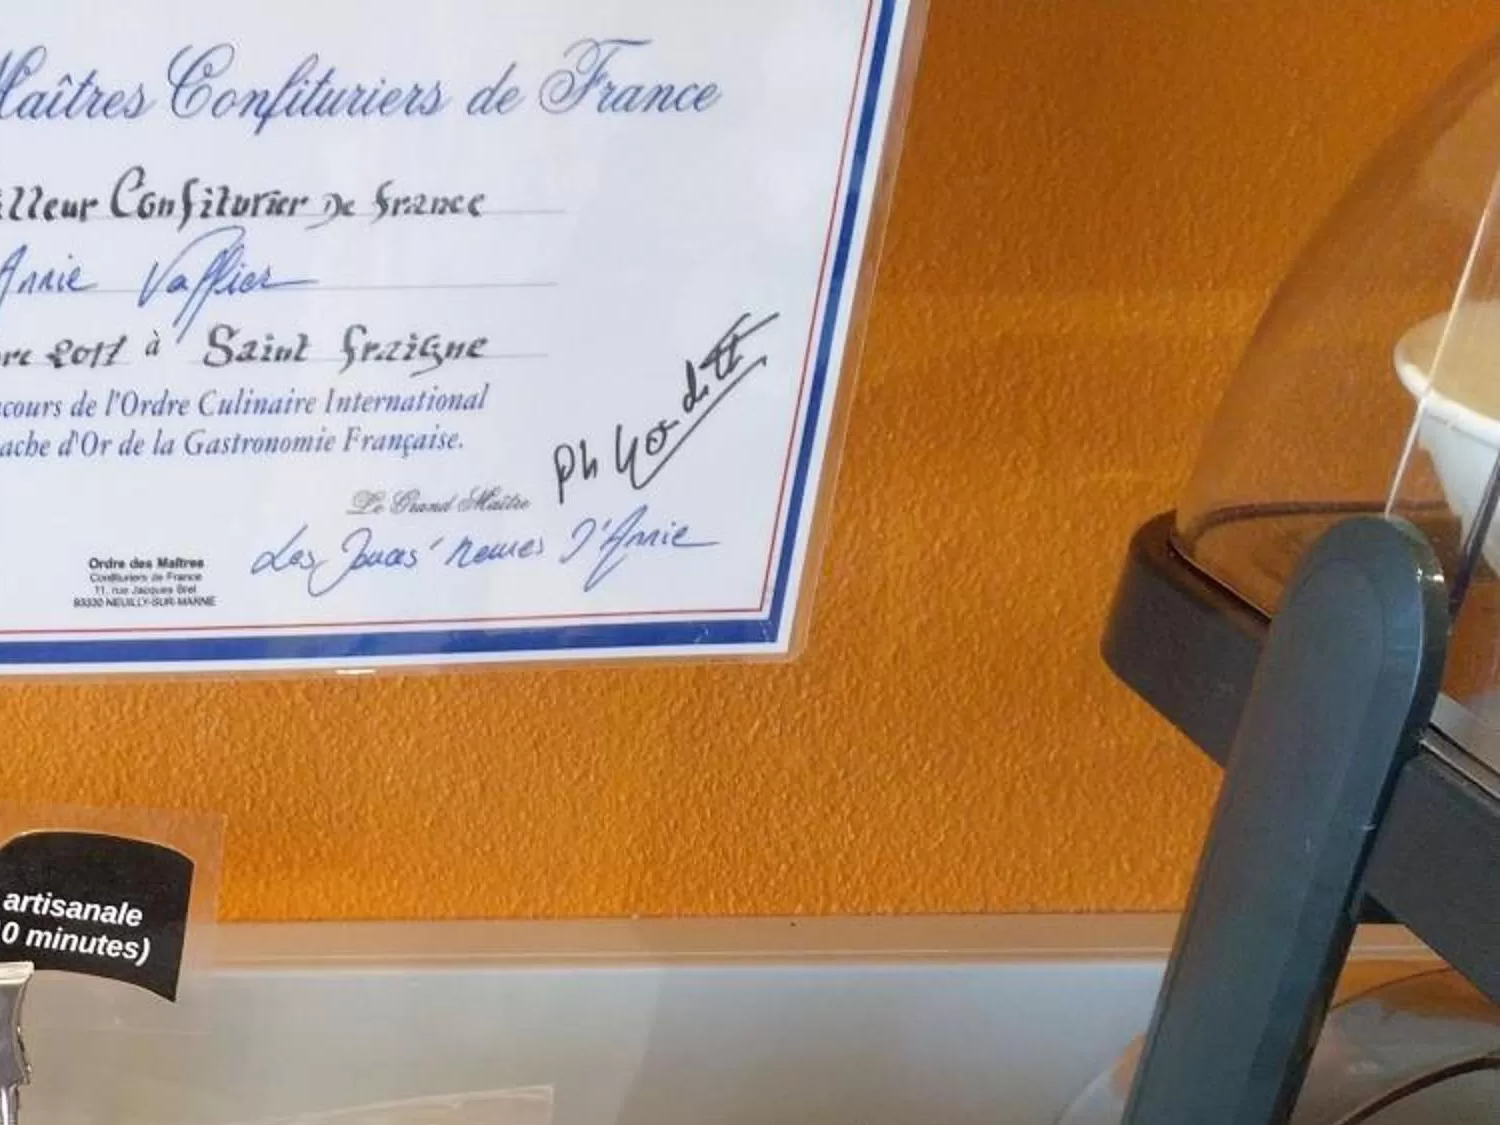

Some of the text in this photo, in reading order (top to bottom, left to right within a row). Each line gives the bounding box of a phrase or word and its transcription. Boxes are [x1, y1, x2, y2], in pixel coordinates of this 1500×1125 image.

[167, 43, 449, 135] Confituriers
[466, 62, 525, 116] de
[538, 38, 722, 116] France
[110, 165, 311, 231] Confiturier
[46, 334, 129, 371] 2017
[144, 331, 160, 359] à
[204, 322, 310, 367] Saint
[71, 390, 98, 418] de
[105, 389, 190, 417] l'Ordre
[198, 386, 316, 417] Culinaire
[323, 383, 490, 414] International
[59, 428, 113, 456] d'Or
[118, 428, 145, 456] de
[153, 427, 175, 455] la
[184, 426, 337, 456] Gastronomie
[343, 425, 465, 459] Française.
[88, 555, 206, 570] Ordre des Maîtres
[2, 889, 145, 930] artisanale
[24, 926, 152, 967] minutes)
